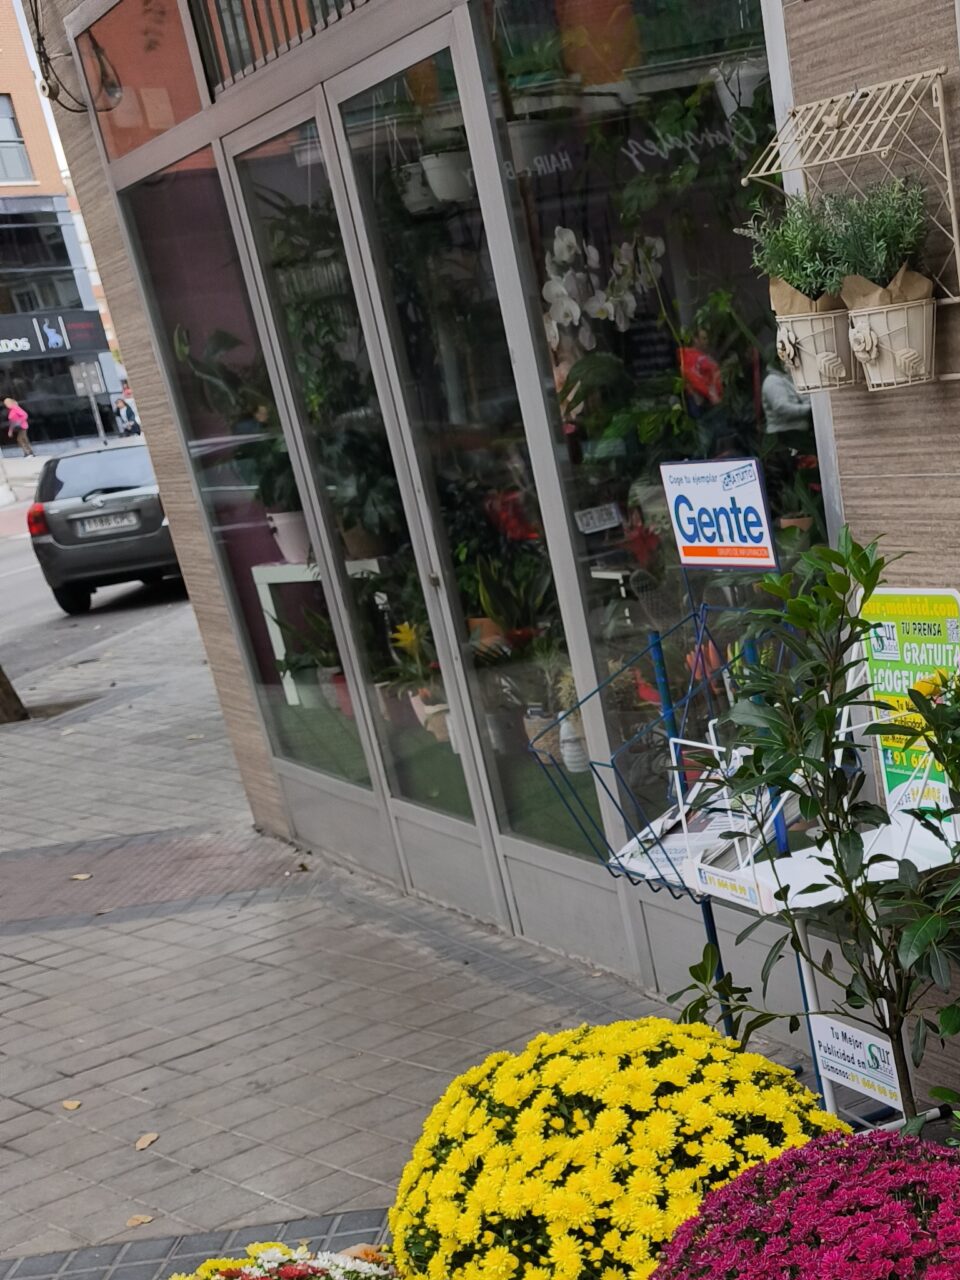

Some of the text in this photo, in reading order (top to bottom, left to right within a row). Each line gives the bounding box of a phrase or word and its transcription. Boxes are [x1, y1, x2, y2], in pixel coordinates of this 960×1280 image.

[0, 337, 31, 353] DOS
[674, 494, 764, 544] Gente
[901, 622, 942, 637] TU PRENSA
[903, 642, 960, 669] GRATUITA
[831, 1027, 862, 1050] Tu Mejor
[818, 1040, 891, 1070] Publicidad en Sur
